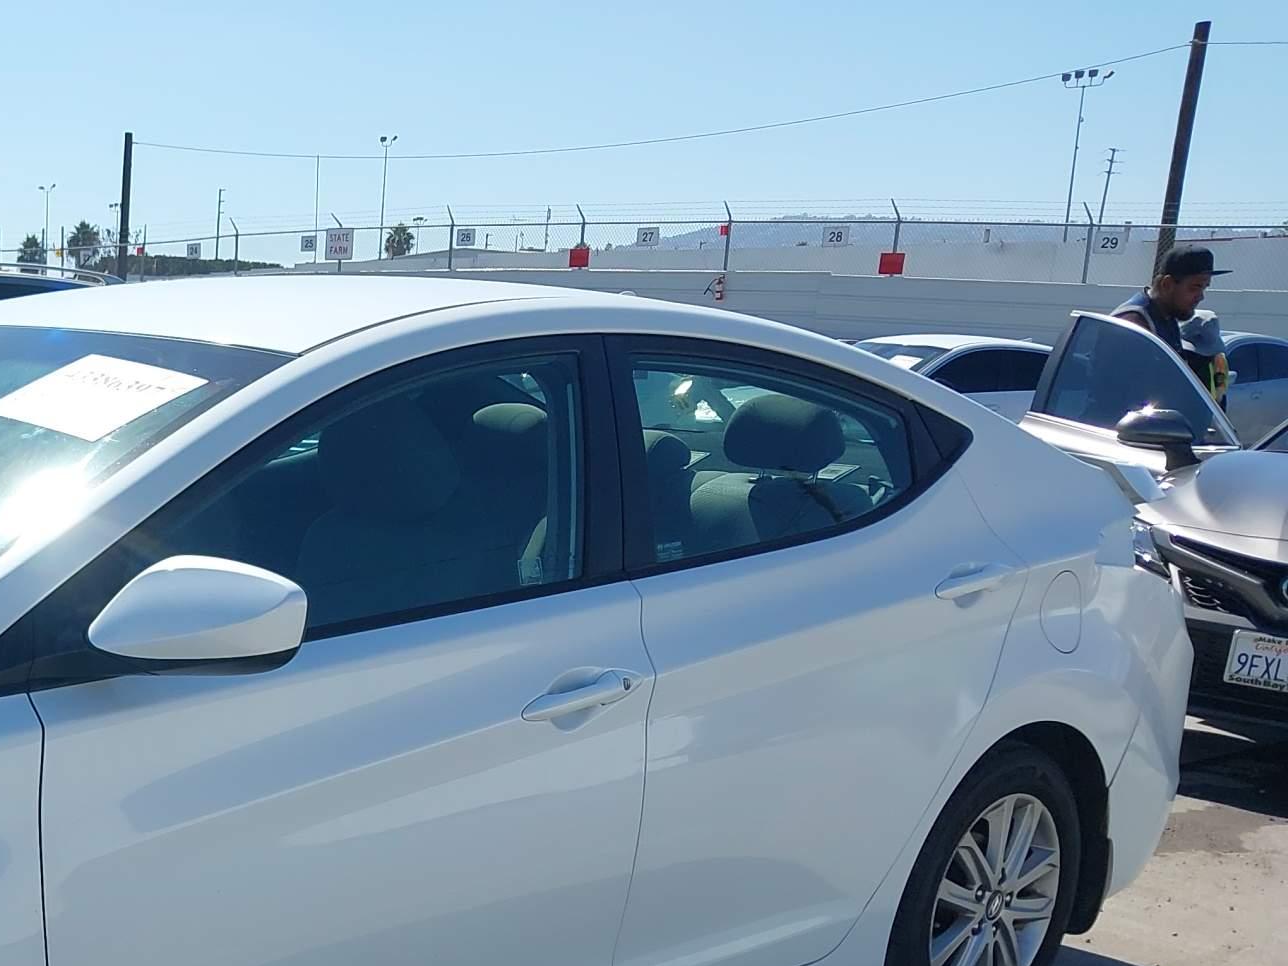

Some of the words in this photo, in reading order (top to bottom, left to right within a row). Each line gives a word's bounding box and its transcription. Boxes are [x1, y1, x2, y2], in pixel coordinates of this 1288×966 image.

[329, 233, 350, 242] STATE
[459, 232, 471, 242] 26
[641, 231, 655, 243] 27
[828, 232, 843, 242] 28
[304, 239, 314, 248] 25
[1100, 237, 1119, 249] 29
[189, 246, 198, 255] 24
